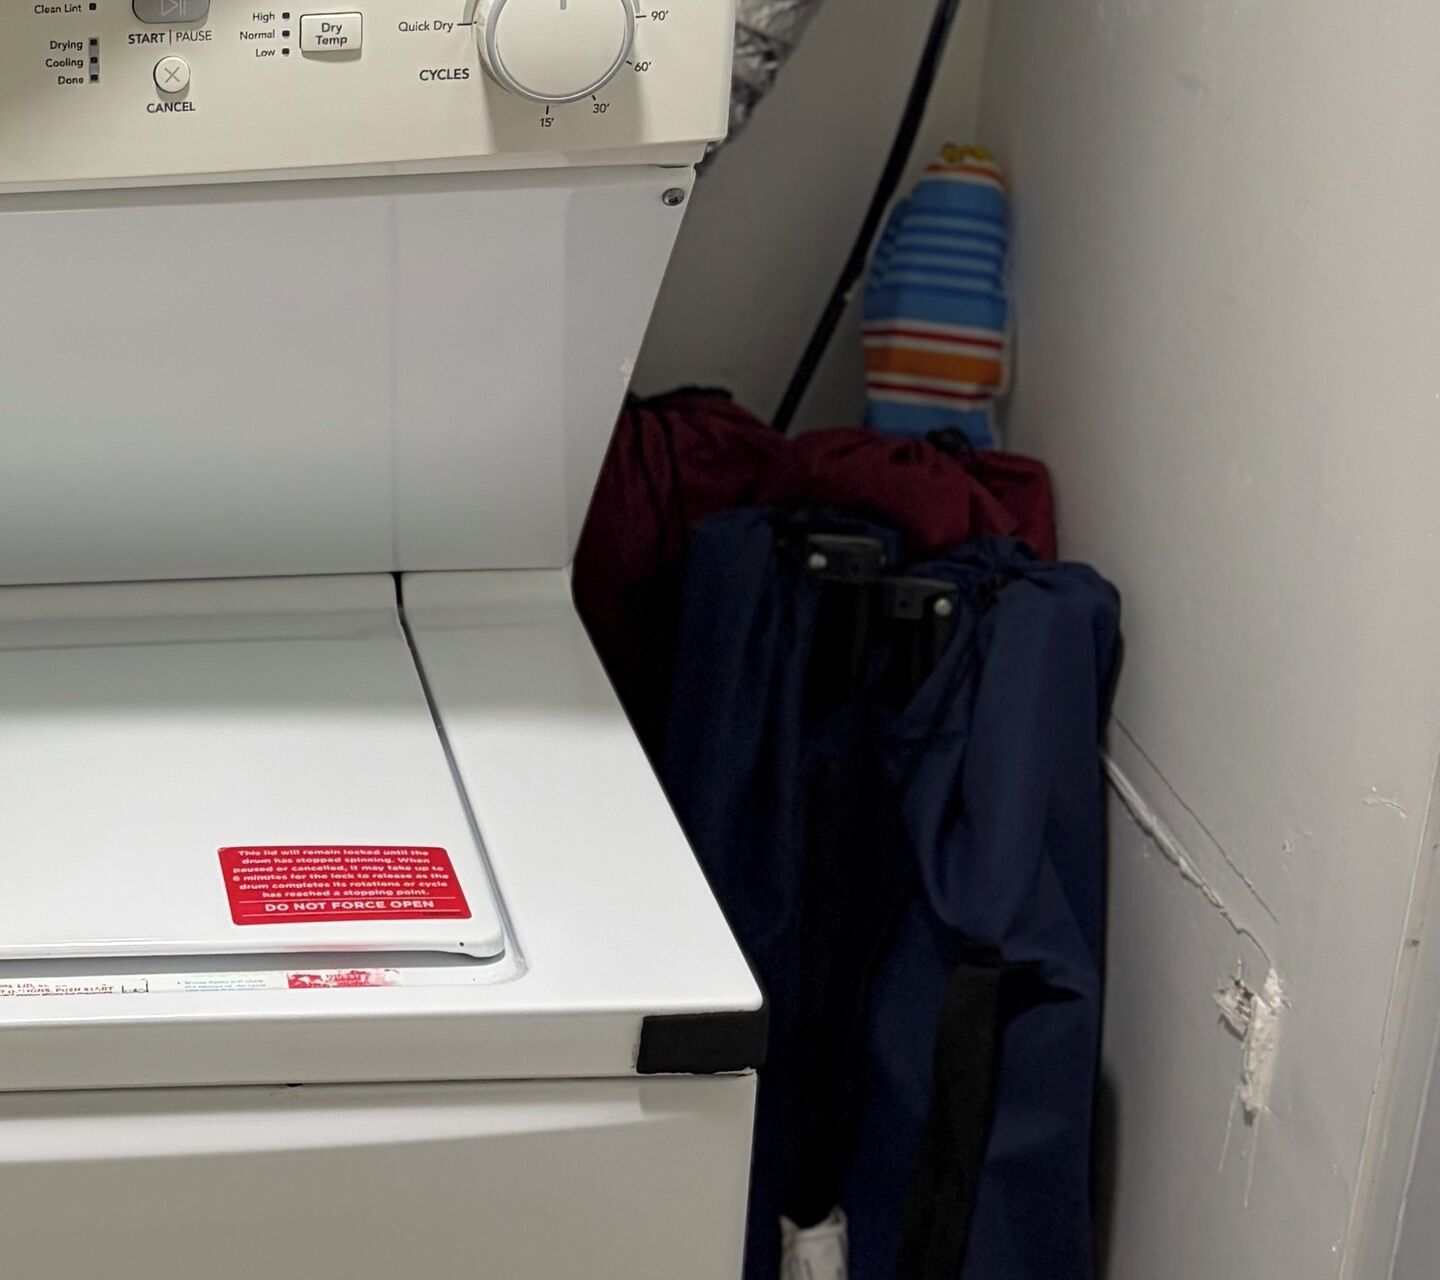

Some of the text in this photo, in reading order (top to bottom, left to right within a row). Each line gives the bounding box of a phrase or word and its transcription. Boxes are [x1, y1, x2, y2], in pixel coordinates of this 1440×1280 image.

[34, 3, 82, 14] Clean Lint
[252, 11, 275, 23] High
[321, 22, 342, 35] Dry
[398, 20, 454, 34] Quick Dry
[127, 33, 165, 44] START
[175, 30, 212, 42] PAUSE
[239, 29, 275, 40] Normal
[315, 34, 348, 47] Temp
[49, 39, 83, 52] Drying
[255, 47, 275, 57] Low
[45, 57, 83, 69] Cooling
[57, 75, 84, 85] Done
[419, 68, 470, 81] CYCLES
[146, 101, 196, 113] CANCEL
[296, 857, 342, 865] stopped
[233, 865, 273, 873] paused
[361, 865, 384, 873] may
[271, 882, 330, 890] completes
[396, 889, 430, 897] point.
[265, 900, 434, 912] DO NOT FORCE OPEN
